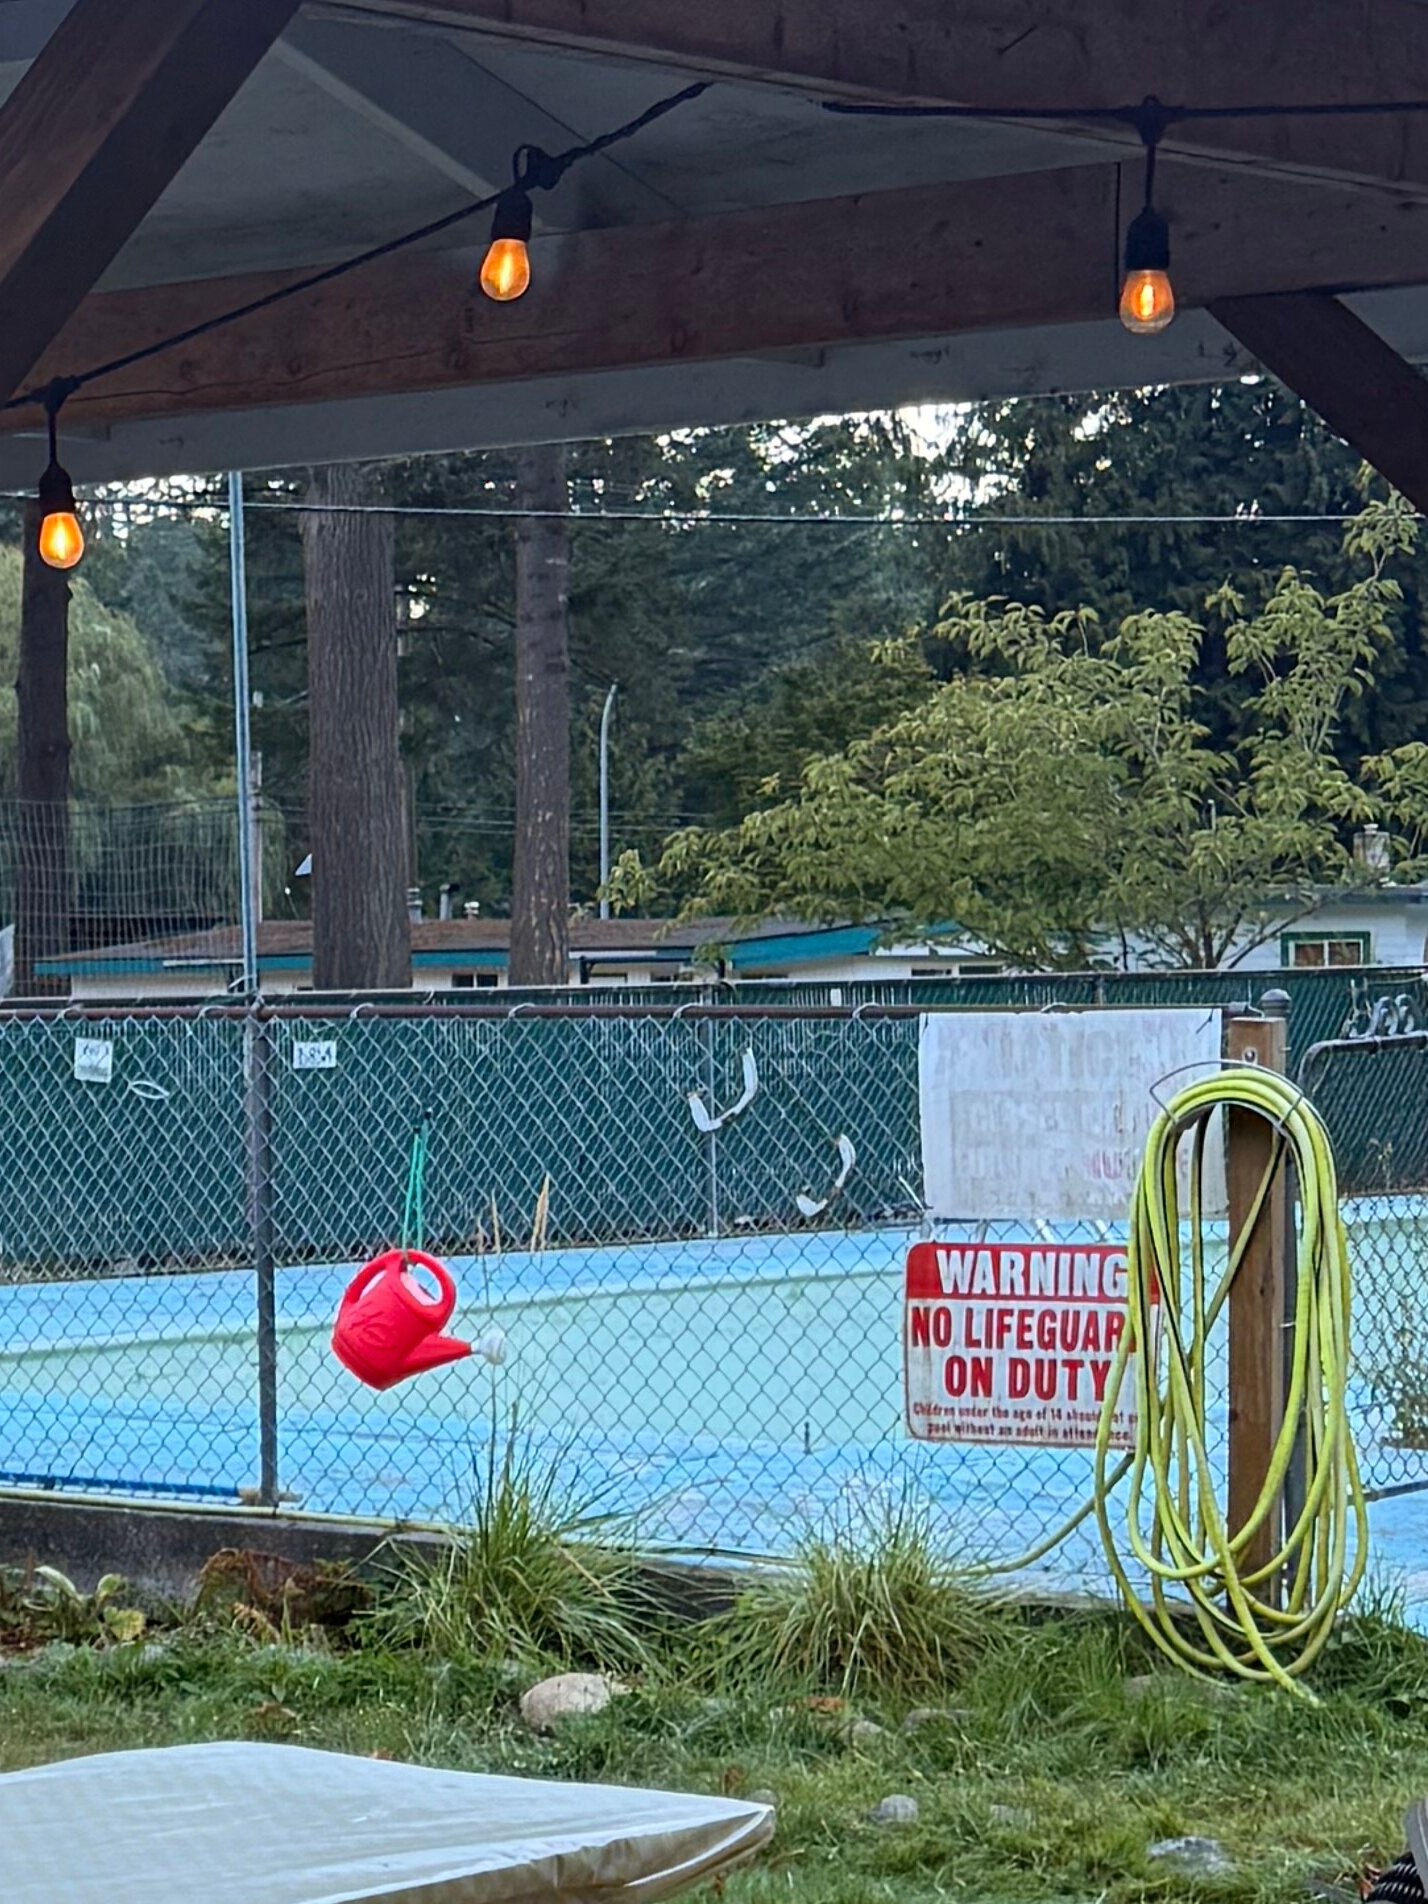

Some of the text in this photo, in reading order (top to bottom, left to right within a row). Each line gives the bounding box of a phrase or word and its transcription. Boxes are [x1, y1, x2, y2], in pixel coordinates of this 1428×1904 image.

[936, 1250, 1129, 1297] WARNING
[912, 1306, 1136, 1353] NO LIFEGUAR
[945, 1355, 1111, 1401] ON DUTY
[913, 1402, 955, 1416] Children
[959, 1405, 988, 1417] under
[992, 1405, 1009, 1418] the
[1013, 1409, 1032, 1422] age
[1036, 1406, 1046, 1420] of
[927, 1422, 950, 1434] pool
[955, 1421, 994, 1435] without
[999, 1426, 1012, 1435] an
[1016, 1424, 1043, 1437] adult
[1048, 1425, 1058, 1438] in
